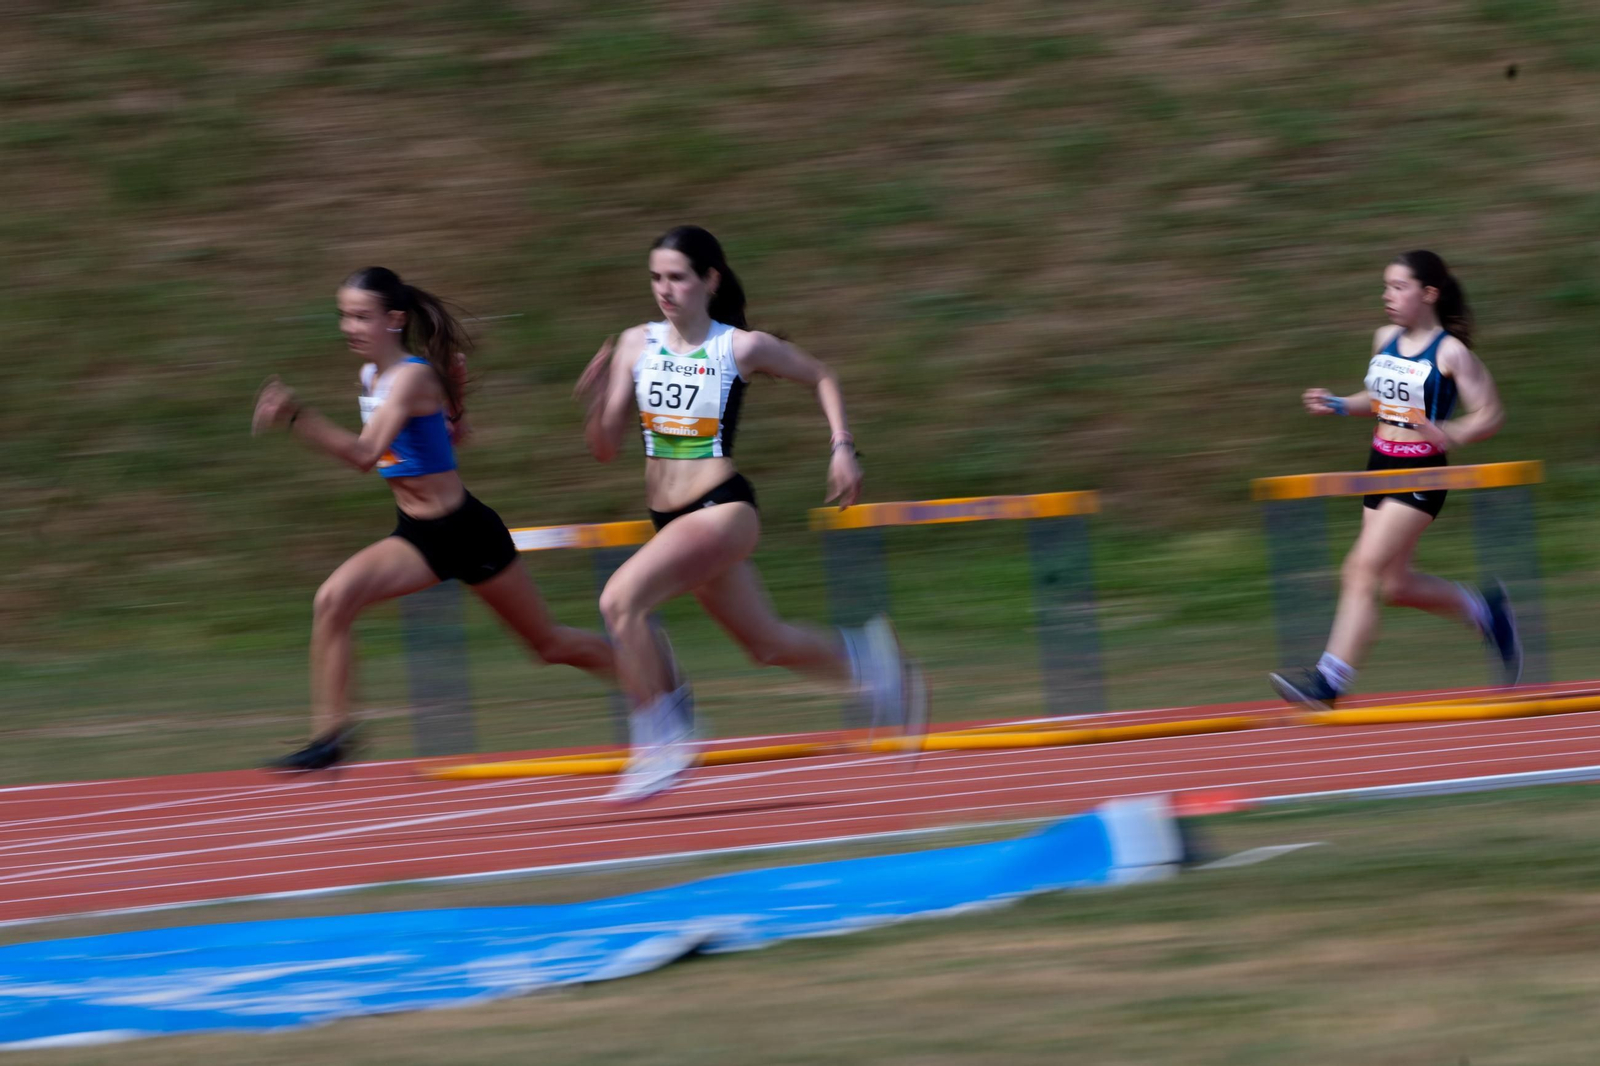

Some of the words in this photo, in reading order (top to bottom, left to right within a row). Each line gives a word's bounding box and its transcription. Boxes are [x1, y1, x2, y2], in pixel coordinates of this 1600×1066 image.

[648, 381, 700, 411] 537
[1371, 376, 1410, 402] 436
[1392, 443, 1433, 454] PRO
